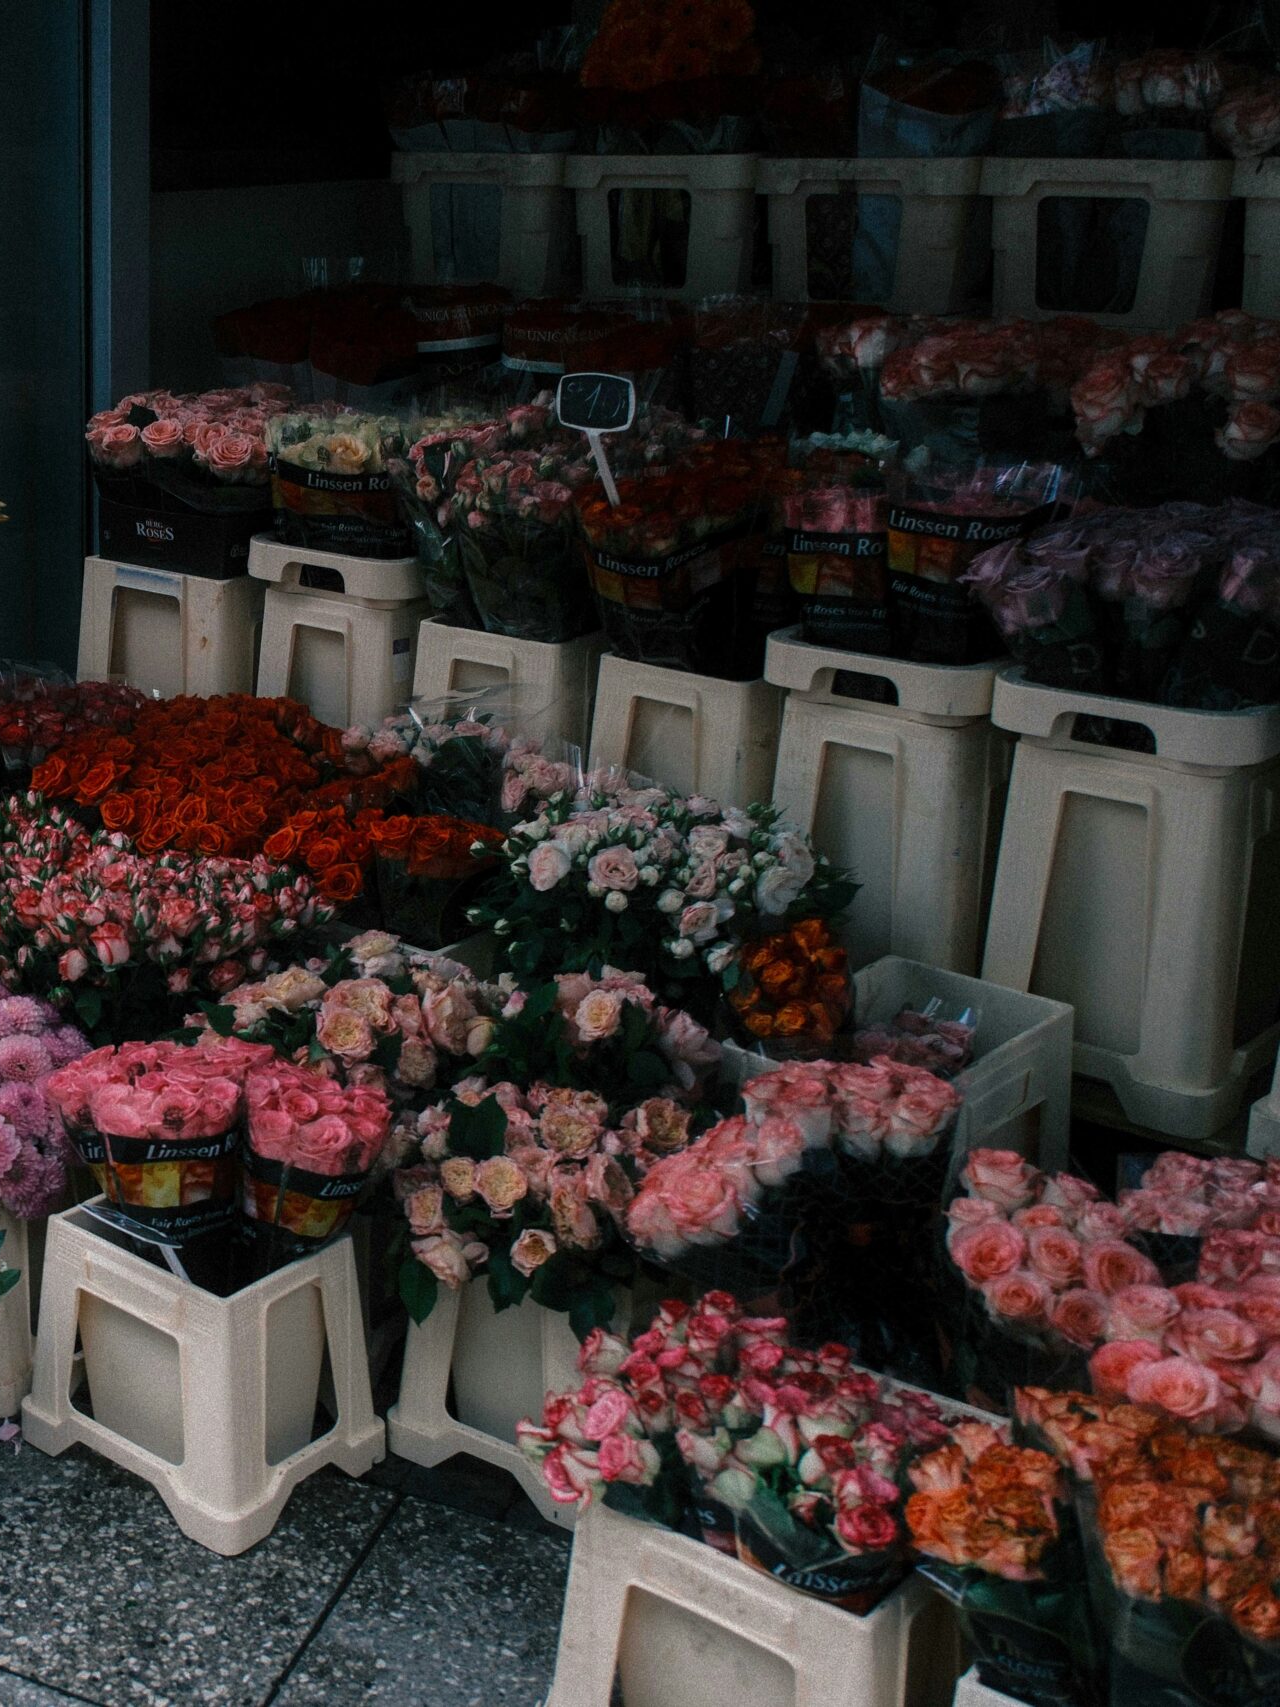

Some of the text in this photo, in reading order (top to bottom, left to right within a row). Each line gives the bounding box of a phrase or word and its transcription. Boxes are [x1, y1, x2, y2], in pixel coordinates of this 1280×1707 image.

[307, 472, 364, 492] Linssen
[888, 509, 1022, 542] Linssen Roses
[792, 533, 851, 556] Linssen
[596, 551, 660, 578] Linssen
[79, 1142, 105, 1160] Lin
[145, 1142, 220, 1161] Linssen
[319, 1178, 363, 1198] Linss
